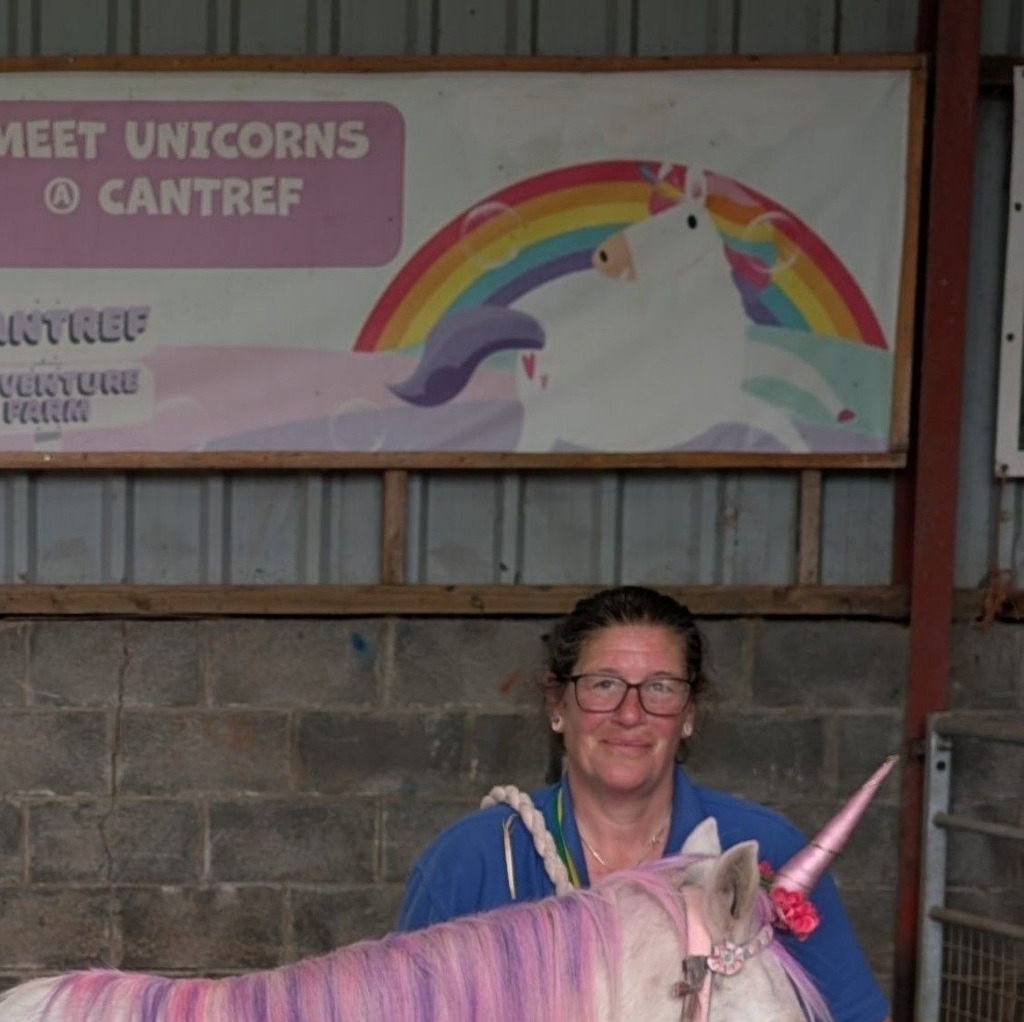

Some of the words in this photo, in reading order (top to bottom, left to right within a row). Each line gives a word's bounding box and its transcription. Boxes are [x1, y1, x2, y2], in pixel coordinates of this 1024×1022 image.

[124, 120, 370, 160] UNICORNS
[98, 177, 304, 217] CANTREF
[3, 398, 92, 425] FARM
